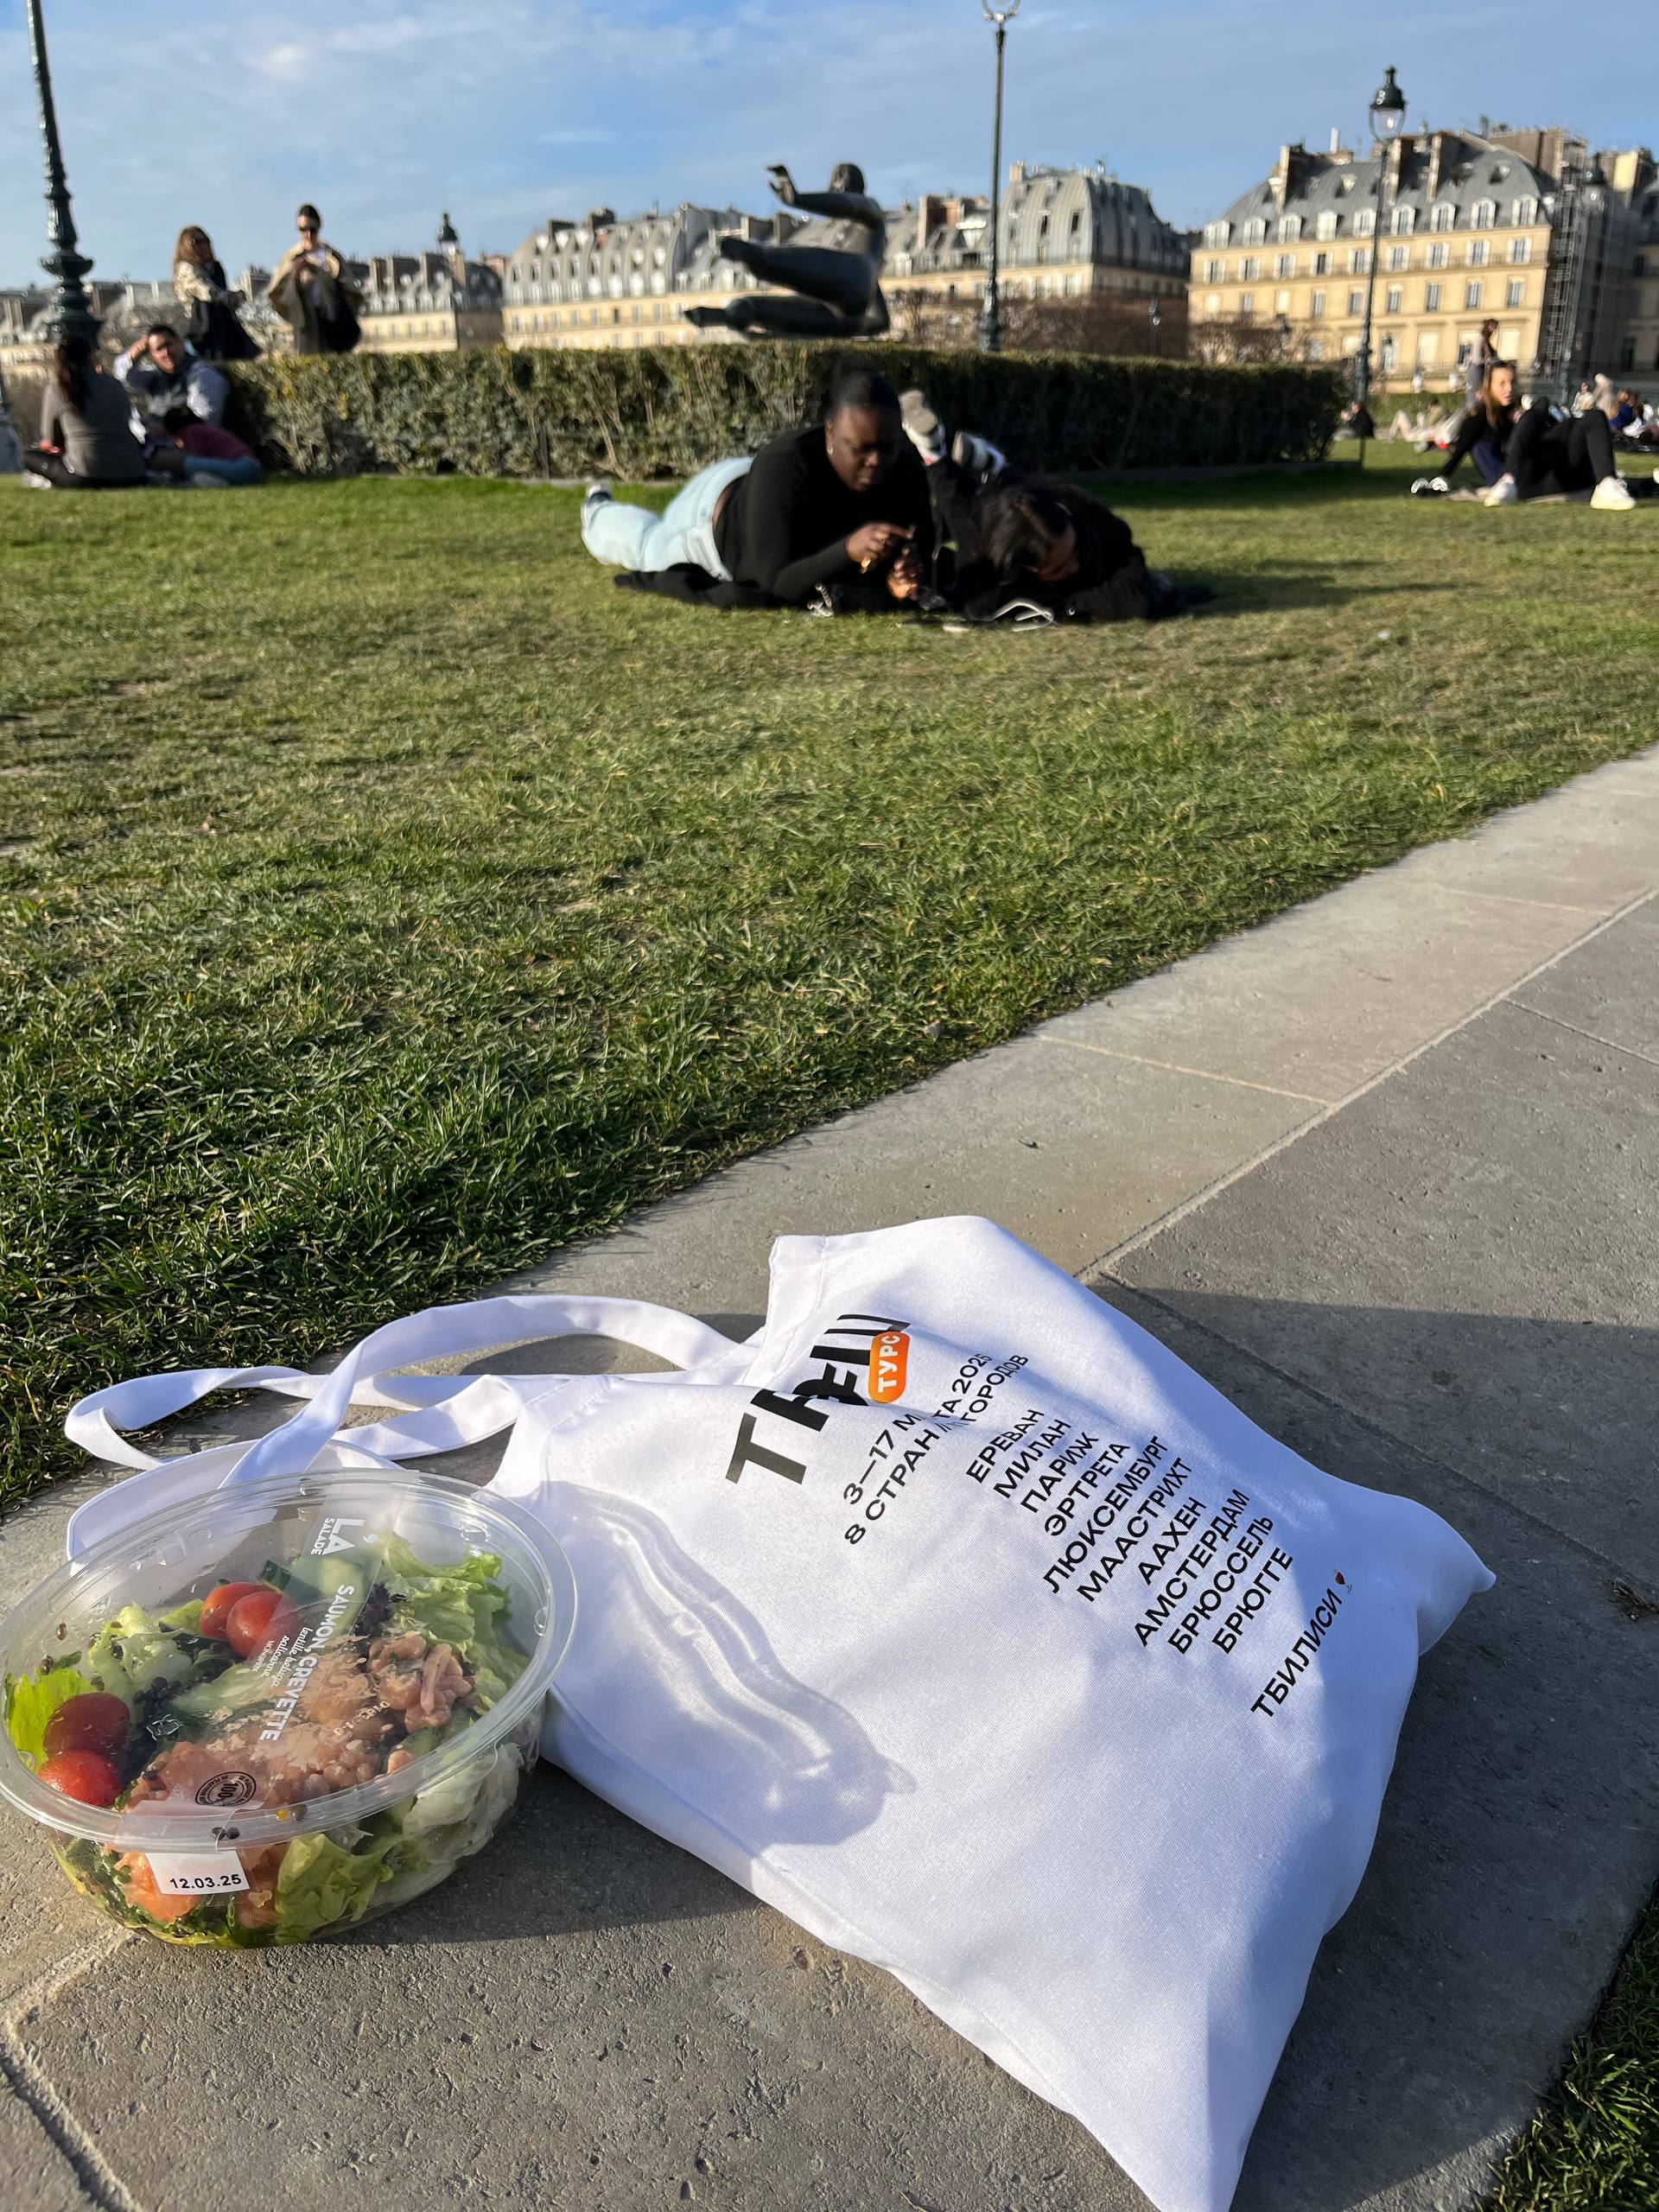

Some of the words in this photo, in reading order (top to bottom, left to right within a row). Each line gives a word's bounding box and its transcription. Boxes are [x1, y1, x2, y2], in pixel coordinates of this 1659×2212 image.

[877, 1335, 900, 1394] ТУРС
[892, 1399, 963, 1432] МТА
[951, 1353, 993, 1395] 2025
[844, 1523, 866, 1545] 8
[865, 1428, 941, 1521] СТРАН
[959, 1354, 1029, 1422] ГОРОДОВ
[966, 1408, 1045, 1484] ЕРЕВАН
[993, 1419, 1071, 1499] МИЛАН
[1020, 1432, 1099, 1514] ПАРИЖ
[1042, 1435, 1168, 1594] ЛЮКСЕМБУРГ
[1044, 1441, 1130, 1537] ЭРТРЕТА
[1077, 1457, 1192, 1603] МААСТРИХТ
[310, 1517, 335, 1555] SALADE
[1133, 1488, 1250, 1647] АМСТЕРДАМ
[1137, 1496, 1207, 1586] ААХЕН
[1166, 1515, 1274, 1656] БРЮССЕЛЬ
[1211, 1547, 1294, 1655] БРЮГГЕ
[262, 1635, 290, 1677] salicorne
[289, 1626, 314, 1656] lentille
[1249, 1587, 1343, 1718] ТБИЛИСИ
[259, 1656, 318, 1741] CREVETTE
[169, 1873, 242, 1889] 12.03.25
